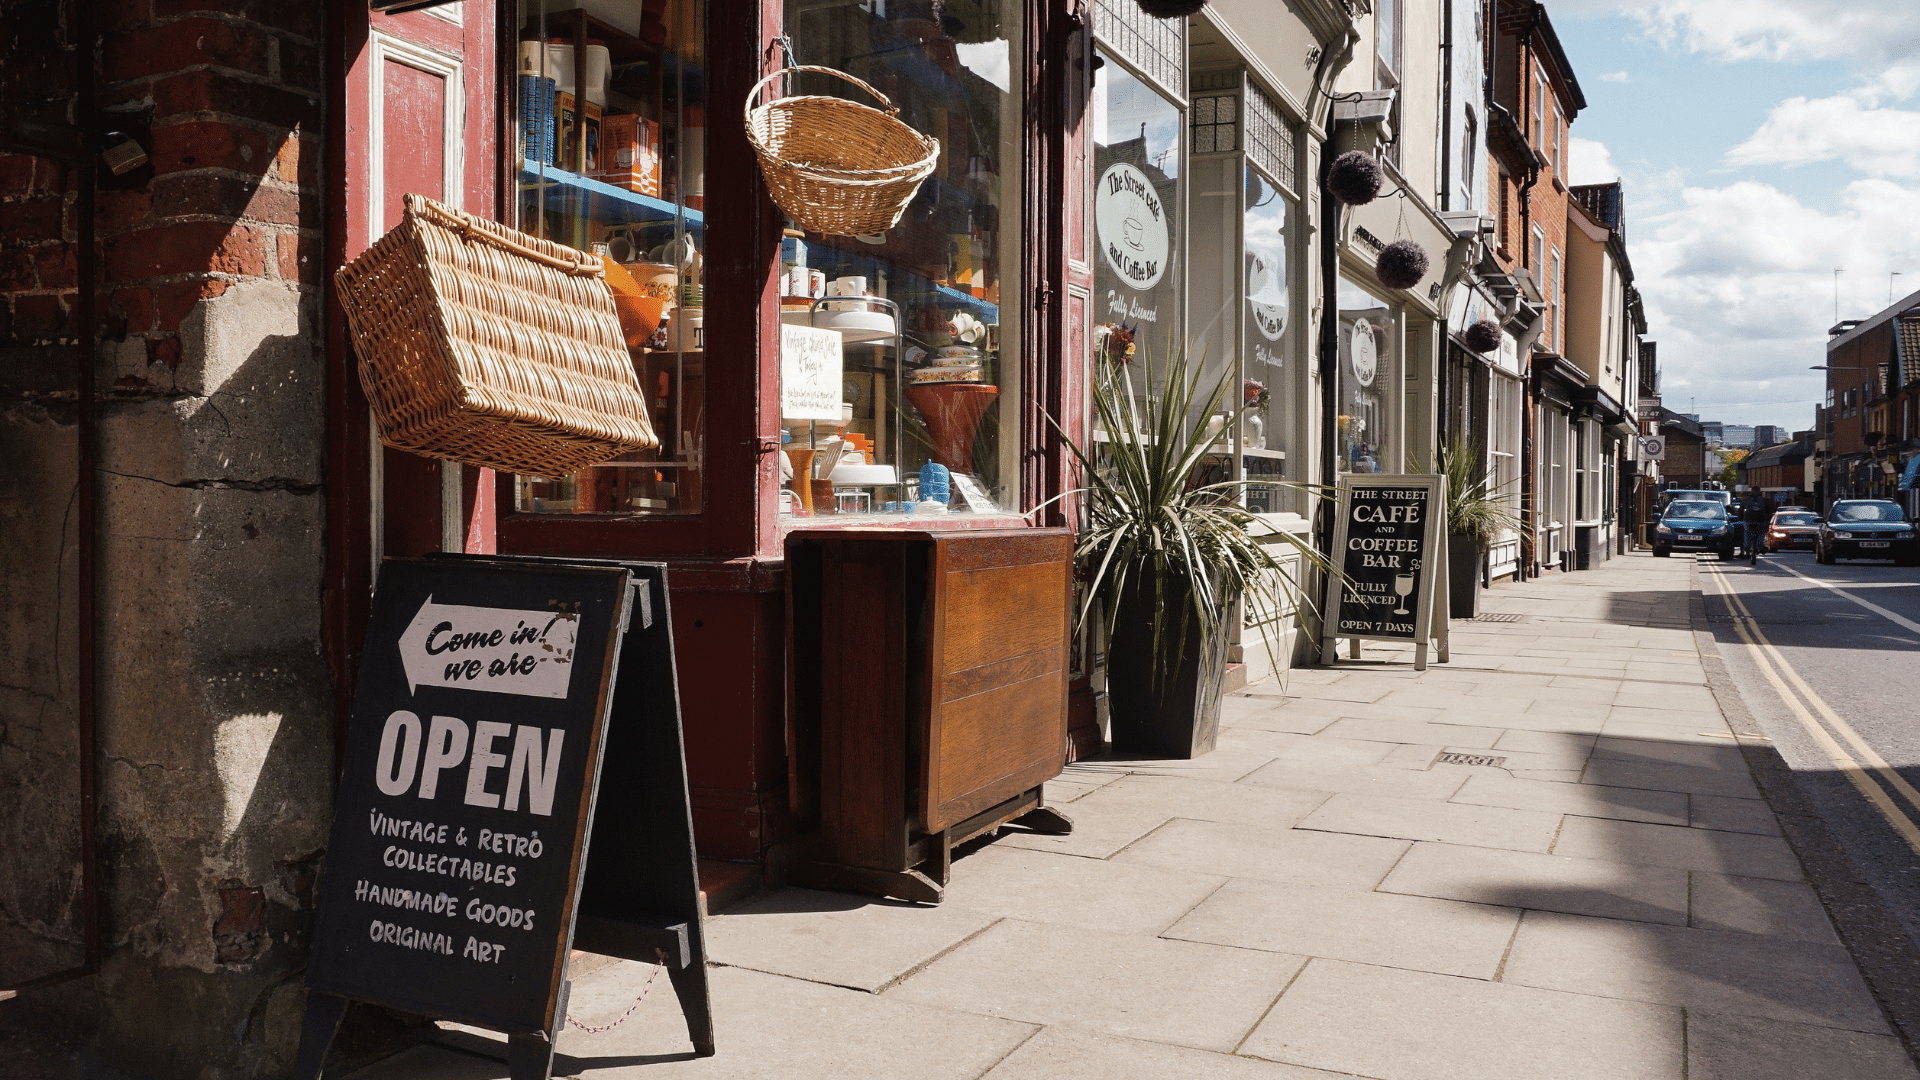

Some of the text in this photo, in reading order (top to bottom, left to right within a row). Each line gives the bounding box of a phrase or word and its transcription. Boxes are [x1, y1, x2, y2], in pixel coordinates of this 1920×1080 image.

[1108, 171, 1123, 196] The
[1125, 170, 1146, 200] Street
[1109, 242, 1158, 281] and Coffee Bar
[1108, 289, 1128, 320] Fully
[1353, 490, 1428, 500] THE STREET
[1353, 502, 1420, 524] CAFÉ
[1349, 537, 1418, 553] COFFEE
[1362, 554, 1401, 568] BAR
[1343, 594, 1396, 605] LICENCED
[1354, 582, 1388, 593] FULLY
[425, 620, 506, 656] Come
[1340, 620, 1414, 633] OPEN 7 DAYS
[443, 652, 539, 682] we are
[375, 709, 566, 817] OPEN
[369, 811, 449, 845] VINTAGE
[455, 826, 468, 847] &
[383, 845, 517, 888] COLLECTABLES
[354, 879, 536, 931] HANDMADE GOODS
[369, 920, 506, 965] ORIGINAL ART
